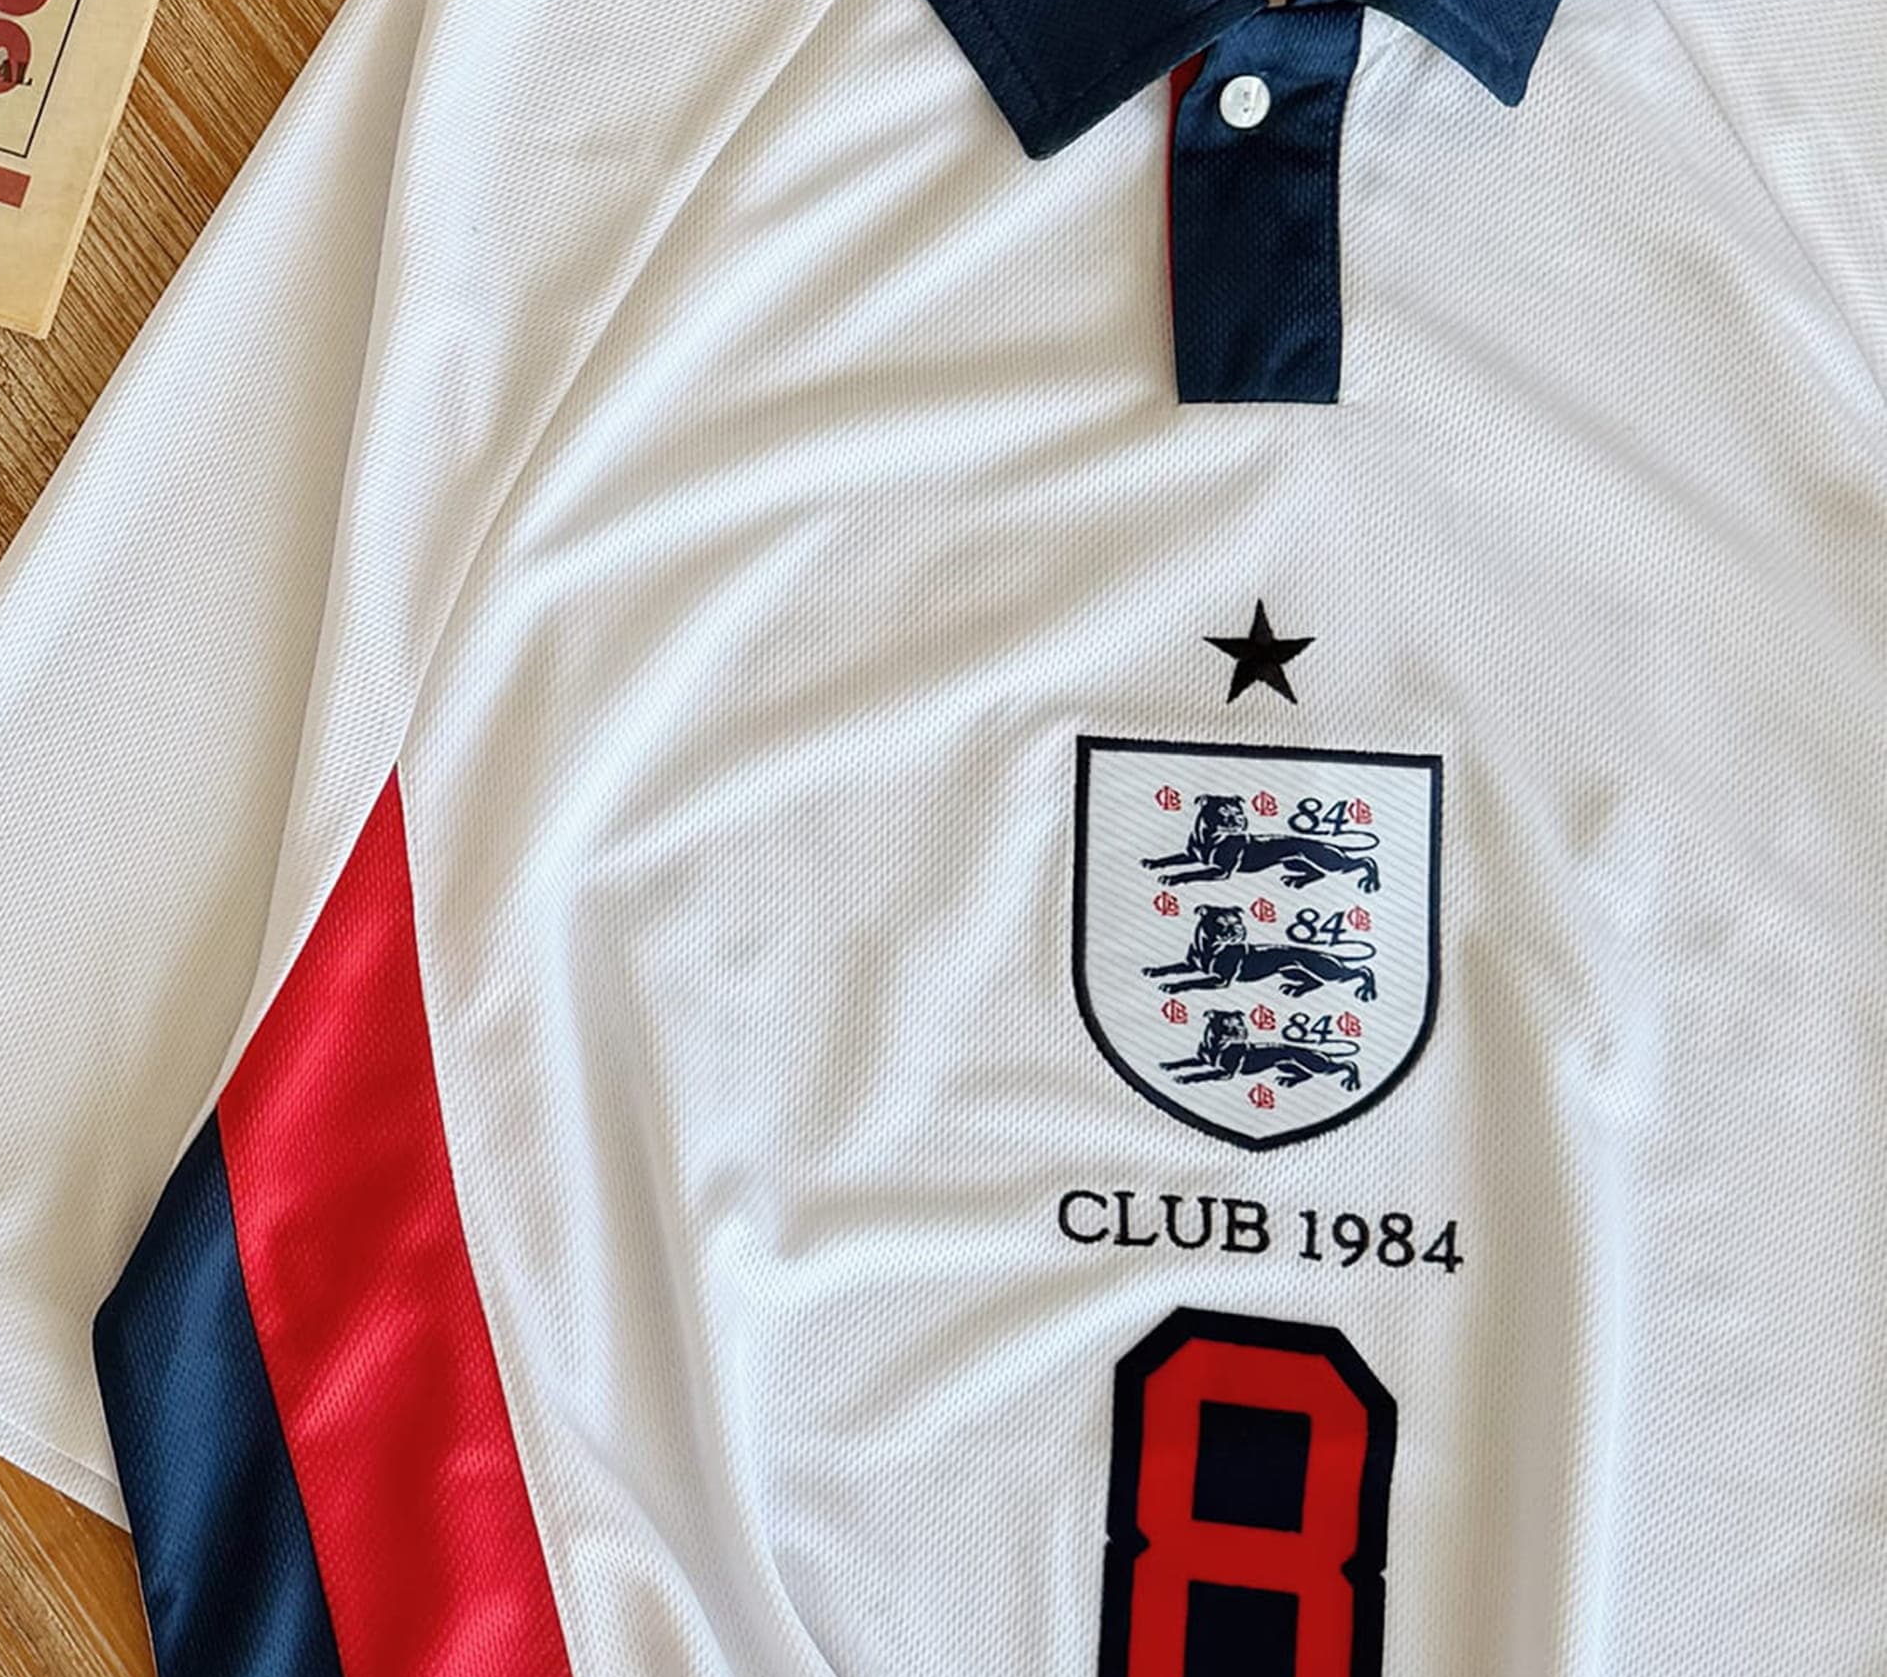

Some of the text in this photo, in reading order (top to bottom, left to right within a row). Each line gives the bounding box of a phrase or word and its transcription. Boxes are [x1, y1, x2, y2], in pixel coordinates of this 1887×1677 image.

[1287, 797, 1350, 836] 84
[1285, 907, 1349, 947] 84
[1281, 1011, 1334, 1044] 84
[1057, 1188, 1465, 1274] CLUB 1984
